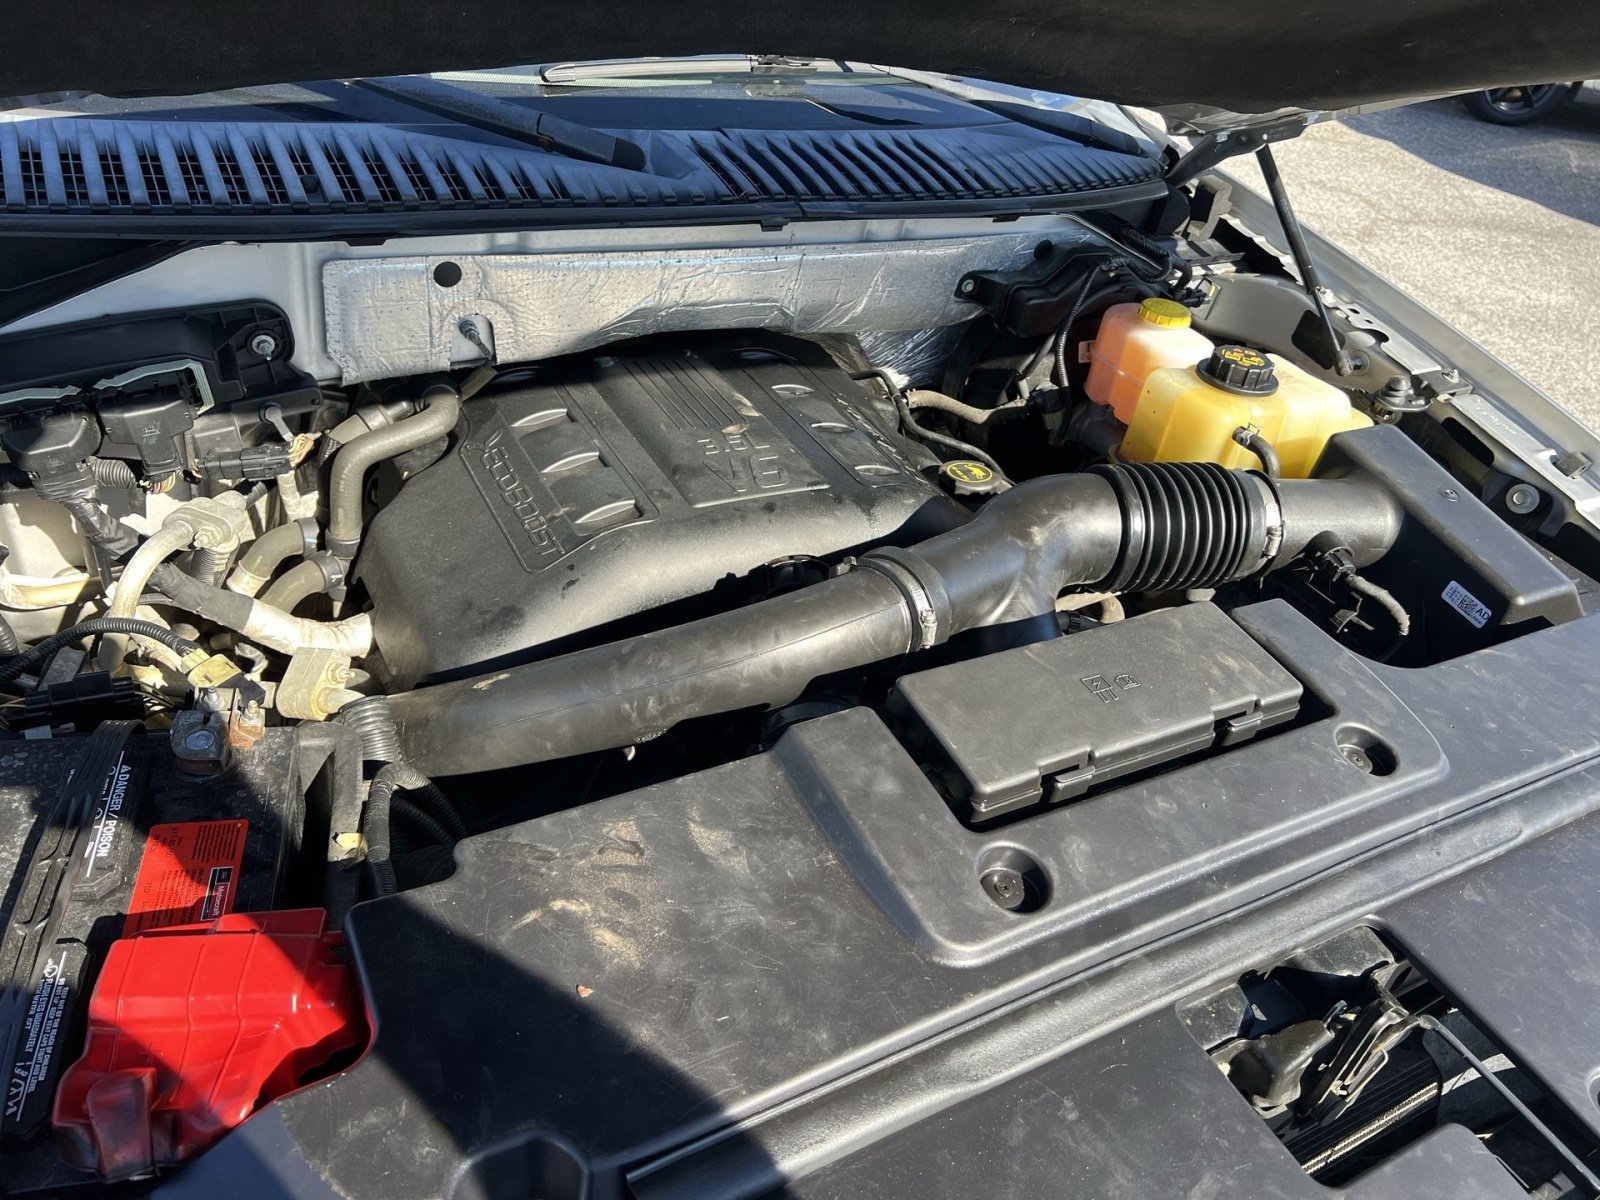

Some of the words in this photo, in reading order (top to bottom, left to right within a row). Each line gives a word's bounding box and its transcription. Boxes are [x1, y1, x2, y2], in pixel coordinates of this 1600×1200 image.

[696, 433, 770, 456] 3.5L
[701, 454, 790, 494] V6
[479, 446, 567, 557] ECOBOOST
[1475, 608, 1490, 620] AD
[109, 773, 129, 811] DANGER
[96, 819, 116, 857] POISON
[212, 885, 224, 916] Motorcraft
[41, 978, 53, 996] FLUSH
[37, 997, 48, 1012] EYES
[25, 1012, 43, 1052] IMMEDIATELY
[41, 1033, 49, 1047] CAPS
[48, 1029, 57, 1046] REACH
[36, 1048, 46, 1063] TIGHT
[38, 1054, 50, 1080] CHILDREN
[32, 1064, 41, 1075] AND
